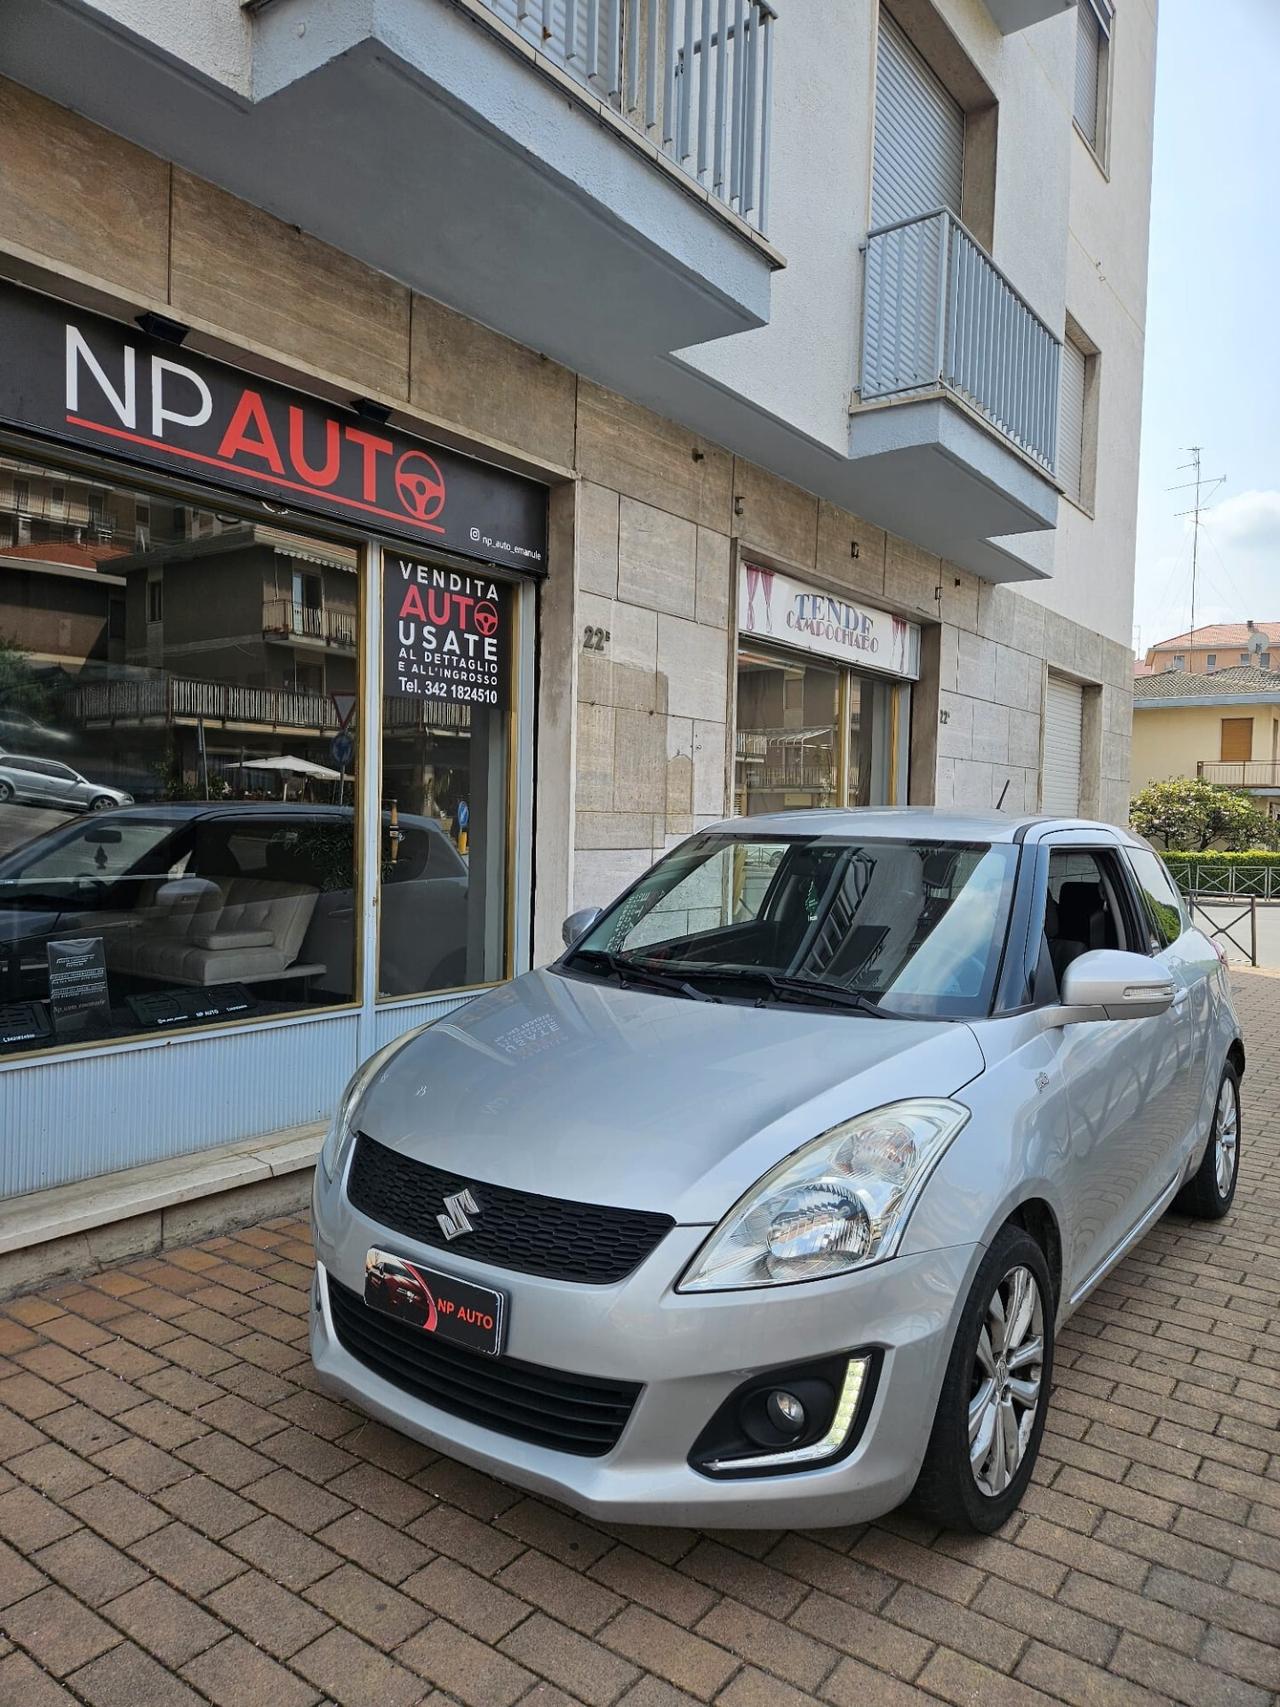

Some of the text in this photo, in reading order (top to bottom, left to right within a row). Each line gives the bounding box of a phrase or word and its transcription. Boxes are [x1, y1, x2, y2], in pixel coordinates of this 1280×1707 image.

[399, 560, 499, 601] VENDITA
[399, 620, 498, 661] USATE
[398, 661, 498, 686] E ALL'INGROSSO
[399, 647, 498, 674] AL DETTAGLIO
[398, 676, 498, 704] Tel. 342 1824510
[437, 1298, 493, 1330] NP AUTO
